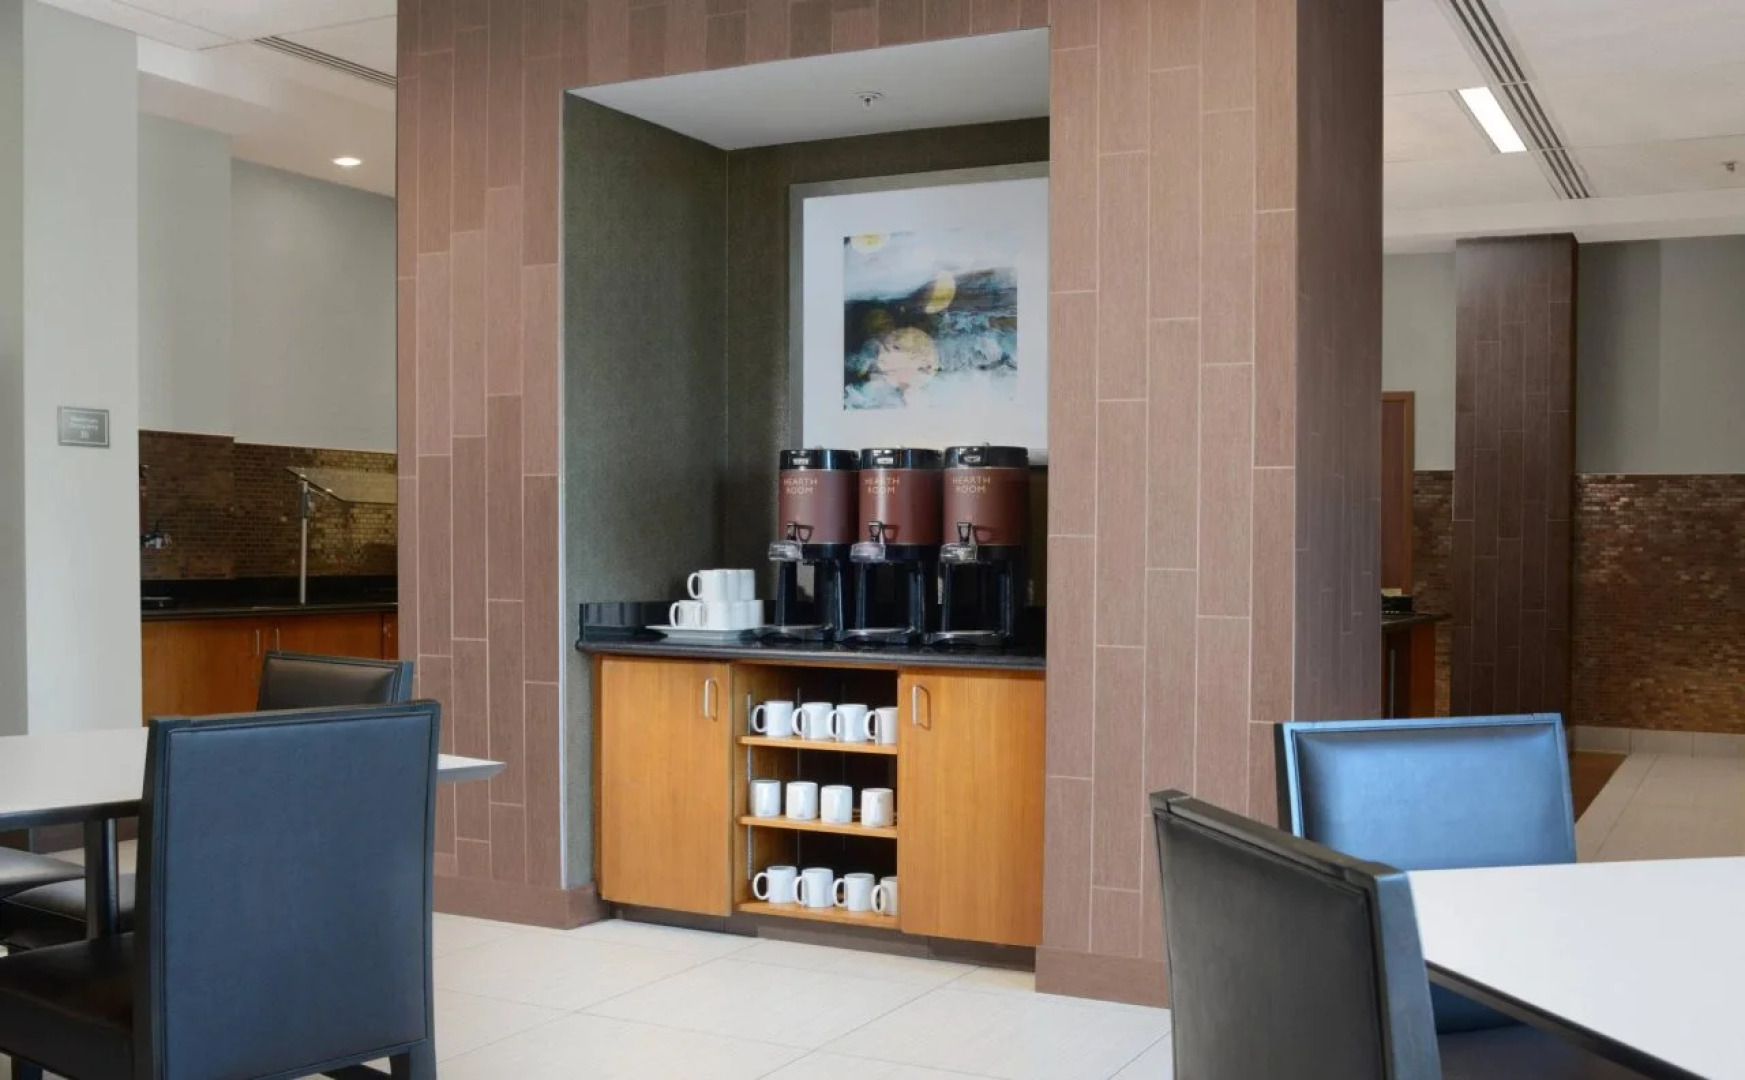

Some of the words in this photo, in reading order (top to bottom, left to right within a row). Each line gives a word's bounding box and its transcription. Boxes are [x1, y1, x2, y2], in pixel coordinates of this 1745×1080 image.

[783, 476, 818, 486] HEARTH
[864, 476, 899, 486] HEARTH
[952, 475, 991, 485] HEARTH
[786, 485, 814, 494] ROOM
[867, 485, 896, 494] ROOM
[956, 484, 987, 493] ROOM
